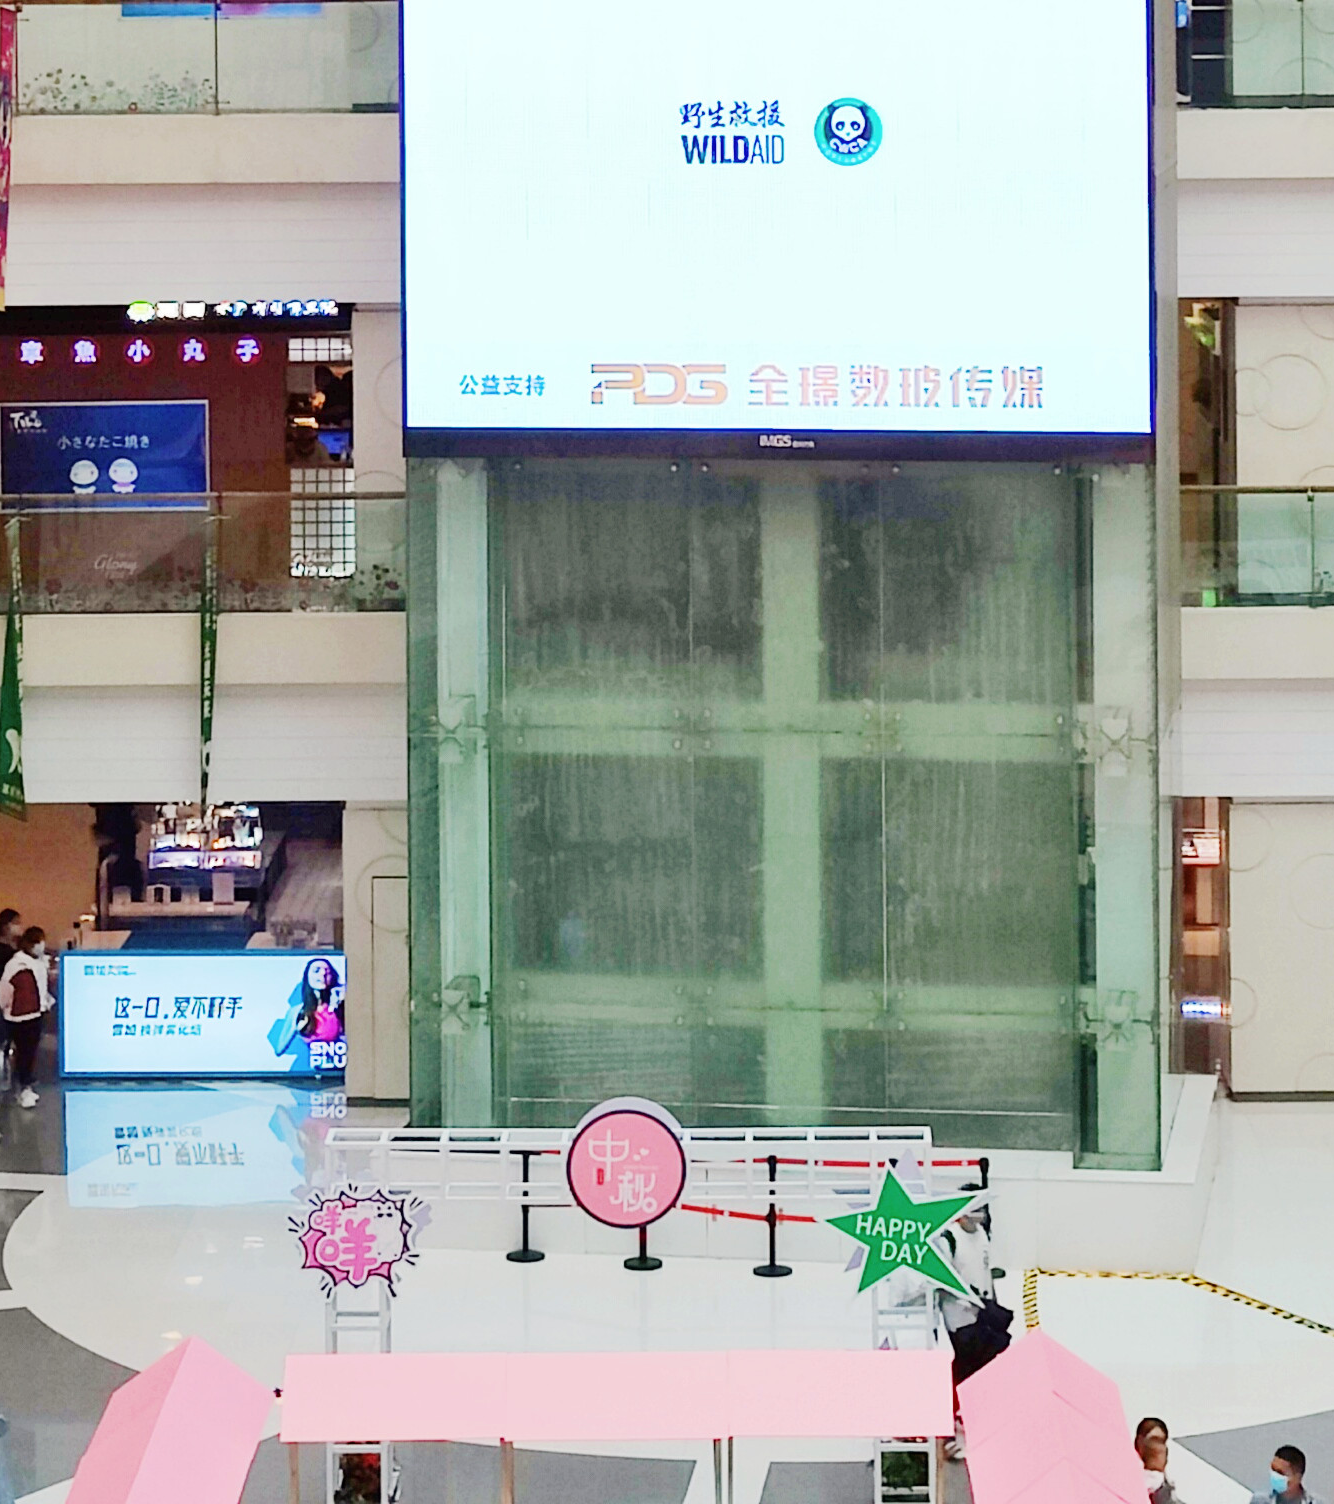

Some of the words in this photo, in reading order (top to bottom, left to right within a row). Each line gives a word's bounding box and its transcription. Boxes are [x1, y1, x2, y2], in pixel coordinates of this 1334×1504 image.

[679, 99, 785, 128] 野生救援
[681, 135, 785, 164] WILDAID
[459, 373, 546, 397] 公益支持
[856, 1213, 932, 1242] HAPPY
[879, 1238, 928, 1266] DAY
